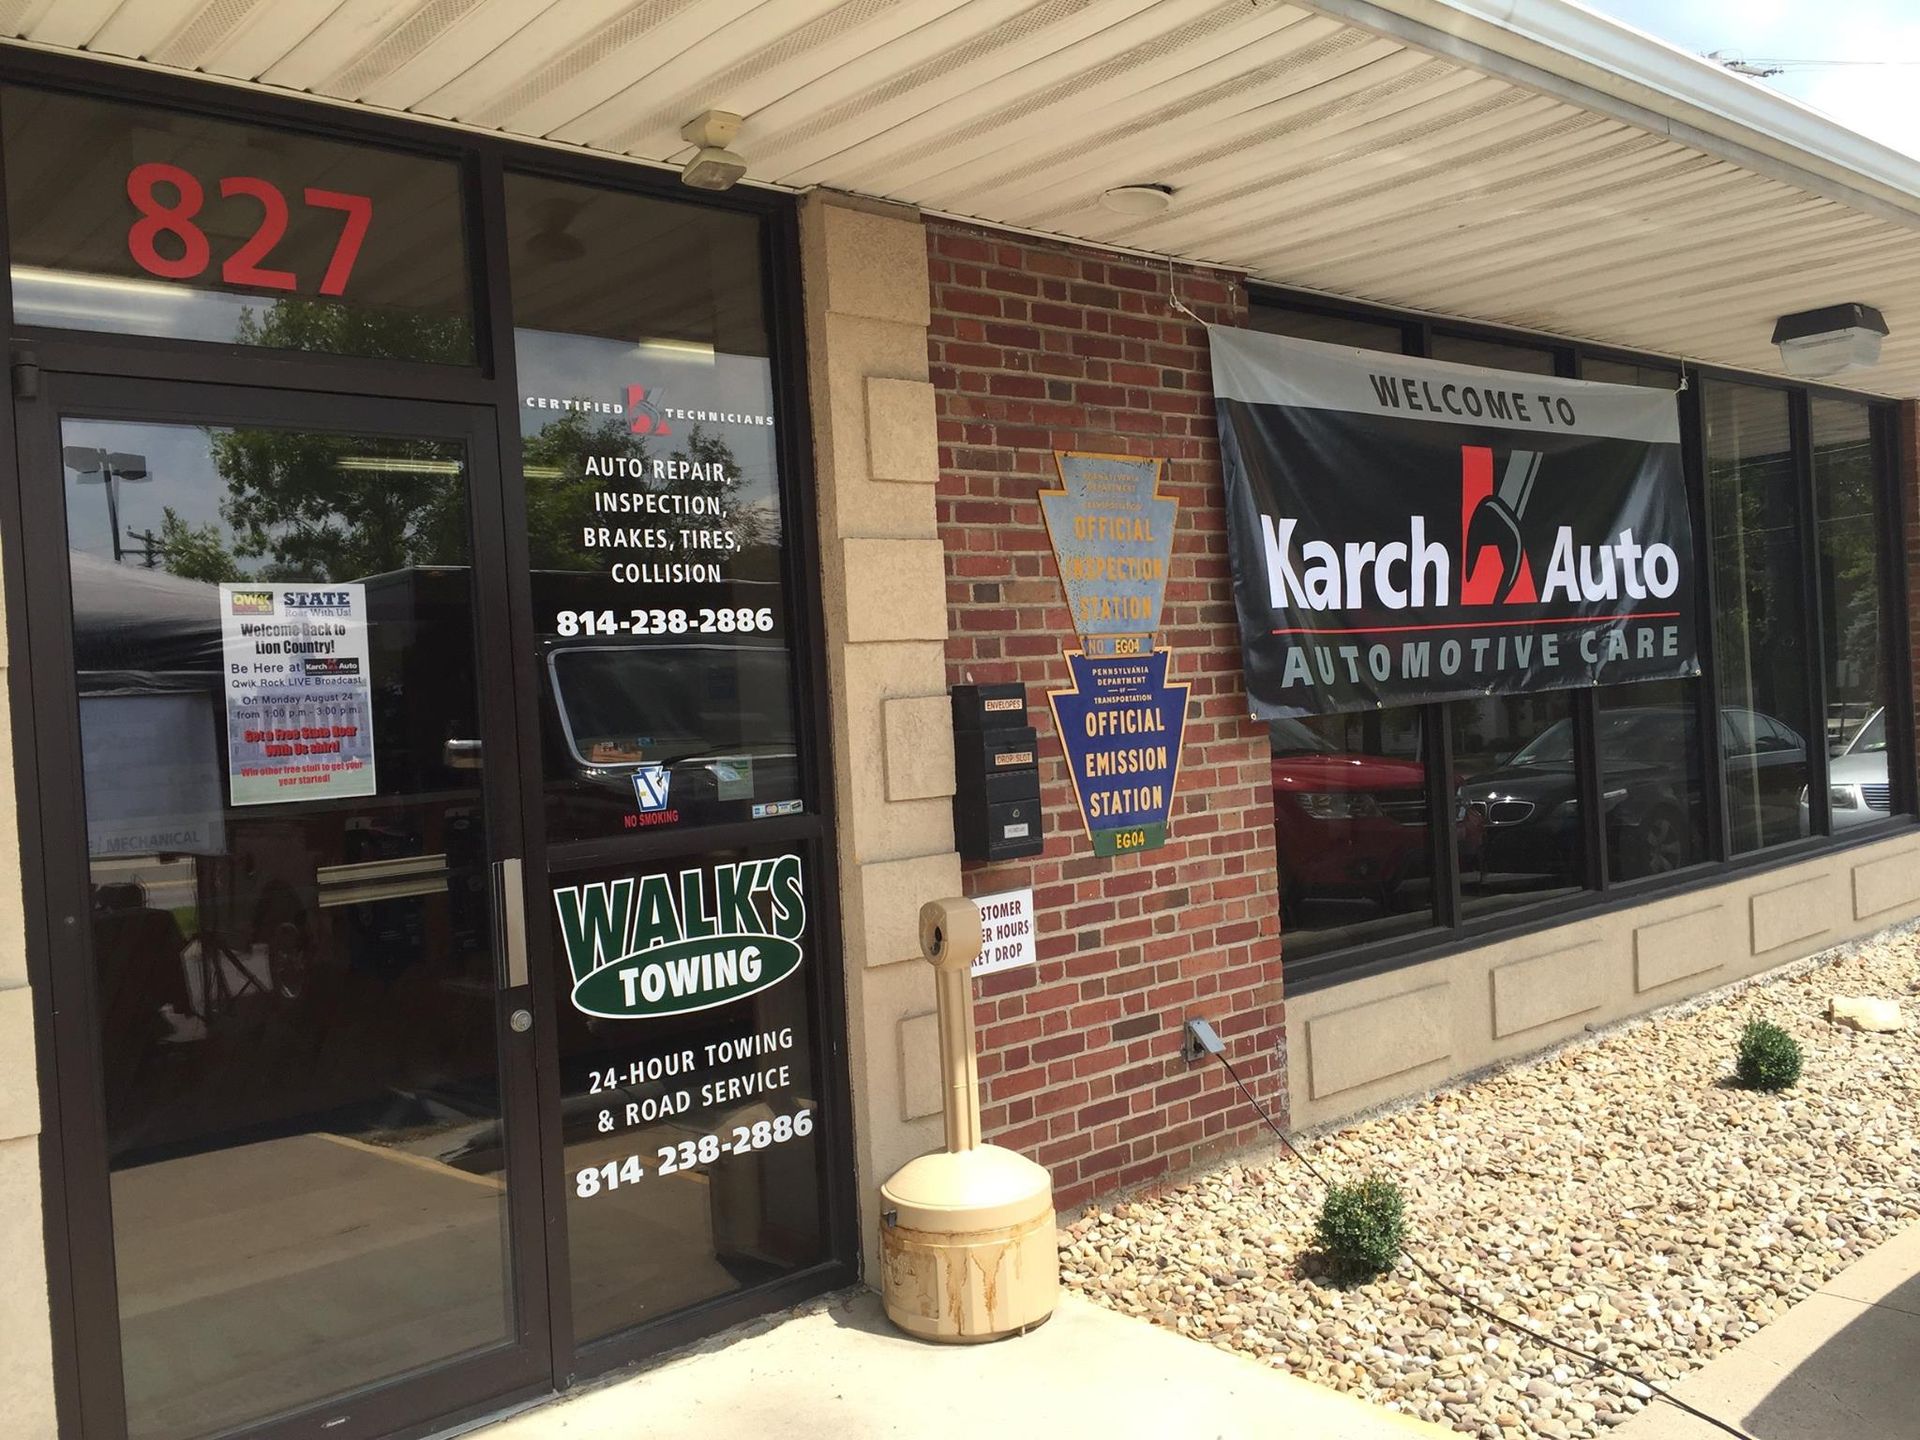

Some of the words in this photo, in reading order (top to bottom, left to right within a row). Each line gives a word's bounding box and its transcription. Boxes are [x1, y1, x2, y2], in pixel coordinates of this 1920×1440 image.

[126, 163, 373, 296] 827
[526, 397, 623, 414] CERTIFIED
[665, 408, 774, 426] TECHNICIANS
[1368, 374, 1531, 423] WELCOME
[1538, 395, 1576, 427] TO
[585, 456, 643, 478] AUTO
[653, 459, 732, 485] REPAIR,
[595, 492, 727, 518] INSPECTION,
[583, 527, 675, 551] BRAKES,
[680, 529, 742, 552] TIRES,
[1074, 515, 1156, 542] OFFICIAL
[611, 563, 722, 584] COLLISION
[1066, 556, 1163, 581] INSPECTION
[1260, 513, 1450, 612] Karch
[1540, 525, 1680, 603] Auto
[284, 592, 350, 606] STATE
[1080, 596, 1153, 621] STATION
[311, 608, 335, 617] With
[336, 608, 352, 617] Us!
[556, 608, 774, 636] 814-238-2886
[241, 623, 300, 637] Welcome
[302, 622, 332, 636] Back
[334, 624, 346, 636] to
[256, 640, 281, 655] Lion
[284, 640, 335, 655] Country!
[1281, 632, 1560, 689] AUTOMOTIVE
[1580, 625, 1679, 663] CARE
[231, 663, 248, 674] Be
[253, 663, 284, 673] Here
[289, 663, 300, 672] at
[306, 662, 327, 670] Karch
[339, 662, 357, 670] Auto
[1092, 666, 1149, 676] PENNSYLVANIA
[231, 679, 257, 688] Qwik
[260, 678, 285, 687] Rock
[289, 678, 311, 686] LIVE
[315, 677, 362, 686] Broadcast
[1097, 676, 1146, 686] DEPARTMENT
[242, 696, 258, 705] On
[262, 695, 300, 705] Monday
[304, 693, 339, 703] August
[342, 693, 353, 701] 24
[987, 700, 1020, 709] ENVELOPES
[1094, 694, 1152, 704] TRANSPORTATION
[236, 710, 260, 719] from
[1085, 708, 1165, 738] OFFICIAL
[244, 730, 264, 742] Get
[275, 729, 300, 741] Free
[265, 744, 293, 757] With
[241, 768, 259, 777] Win
[260, 766, 283, 776] other
[284, 765, 301, 774] free
[322, 763, 330, 771] to
[331, 762, 345, 772] get
[1086, 746, 1167, 778] EMISSION
[1090, 785, 1163, 817] STATION
[624, 814, 637, 828] NO
[639, 810, 679, 826] SMOKING
[106, 831, 200, 850] MECHANICAL
[553, 854, 806, 985] WALK'S
[981, 900, 1022, 922] STOMER
[996, 920, 1030, 940] HOURS
[995, 942, 1023, 962] DROP
[619, 946, 763, 1007] TOWING
[588, 1050, 696, 1095] 24-HOUR
[704, 1027, 793, 1067] TOWING
[597, 1109, 614, 1133] &
[626, 1091, 691, 1126] ROAD
[701, 1065, 791, 1107] SERVICE
[575, 1155, 644, 1199] 814
[657, 1109, 814, 1177] 238-2886
